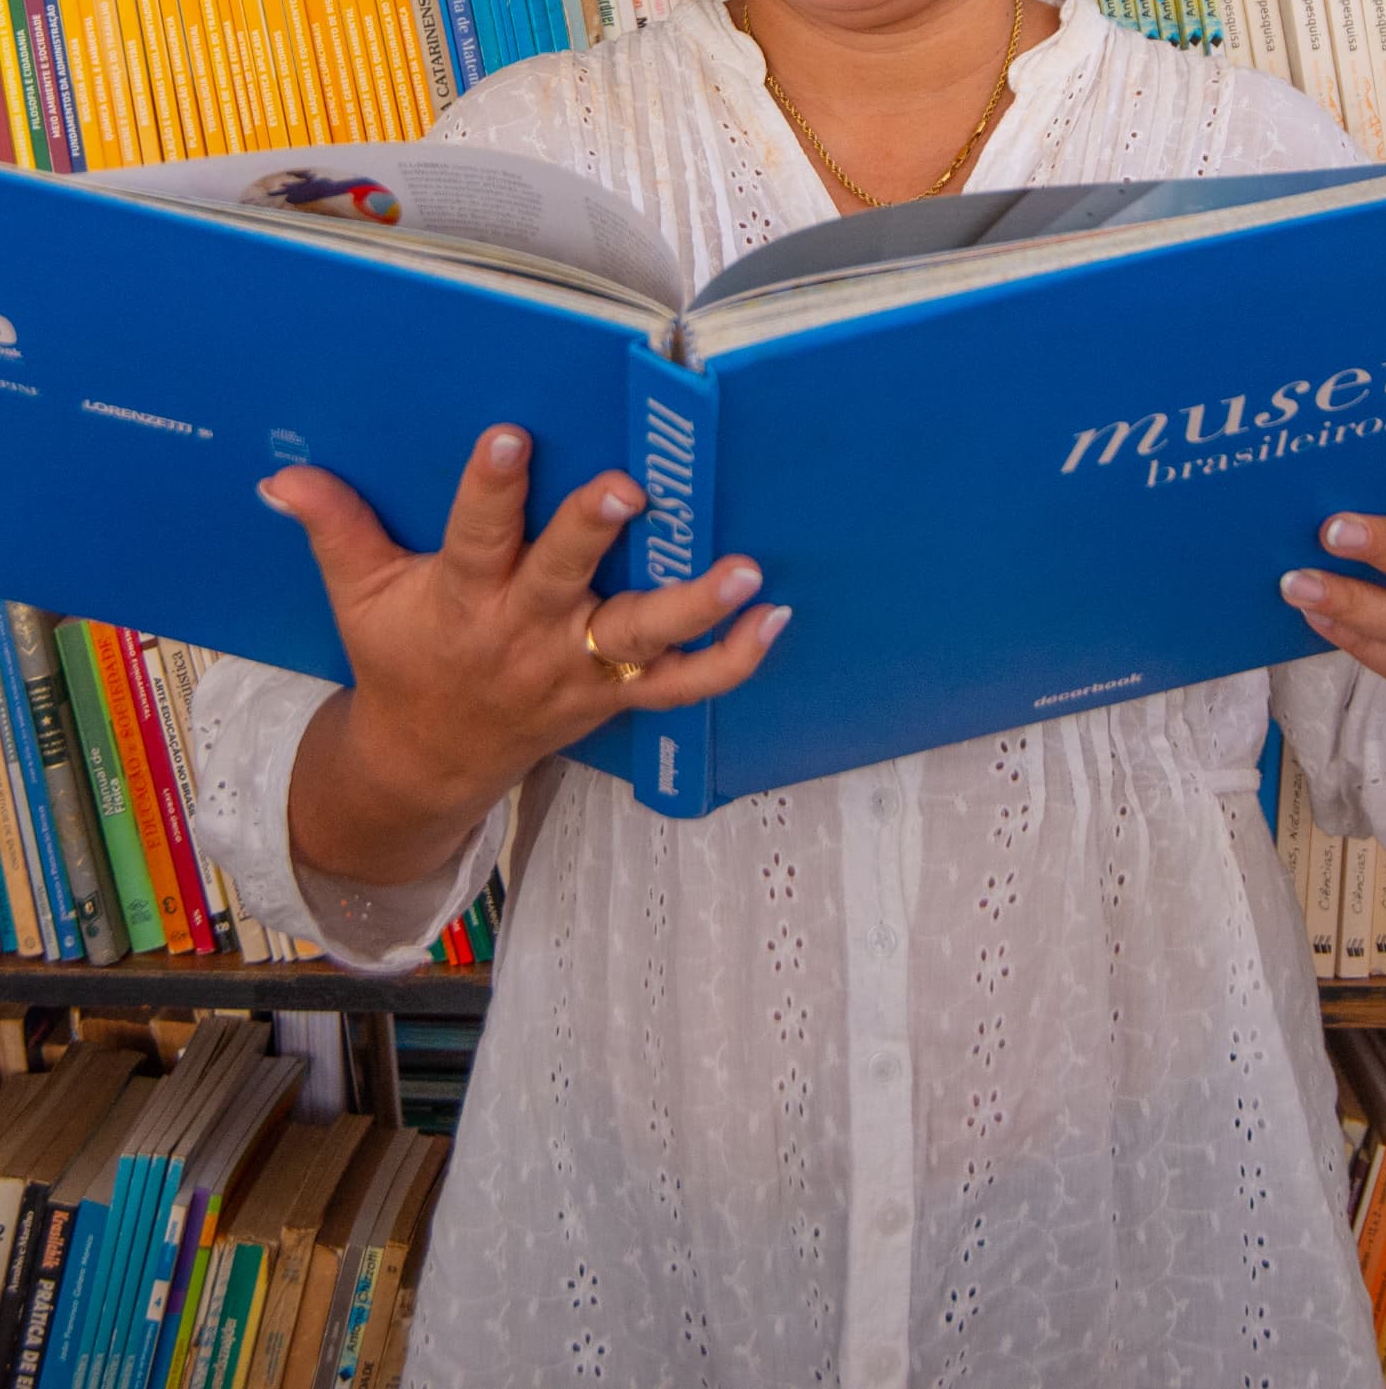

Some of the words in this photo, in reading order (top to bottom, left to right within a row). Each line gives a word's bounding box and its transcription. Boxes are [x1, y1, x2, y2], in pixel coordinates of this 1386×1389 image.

[31, 13, 49, 61] SOCIEDADE
[40, 70, 58, 114] AMBIENTE
[48, 115, 62, 138] MEIO
[82, 398, 193, 436] LORENZETTI
[1033, 672, 1143, 709] decorbook
[22, 1277, 59, 1348] PRÁTICA
